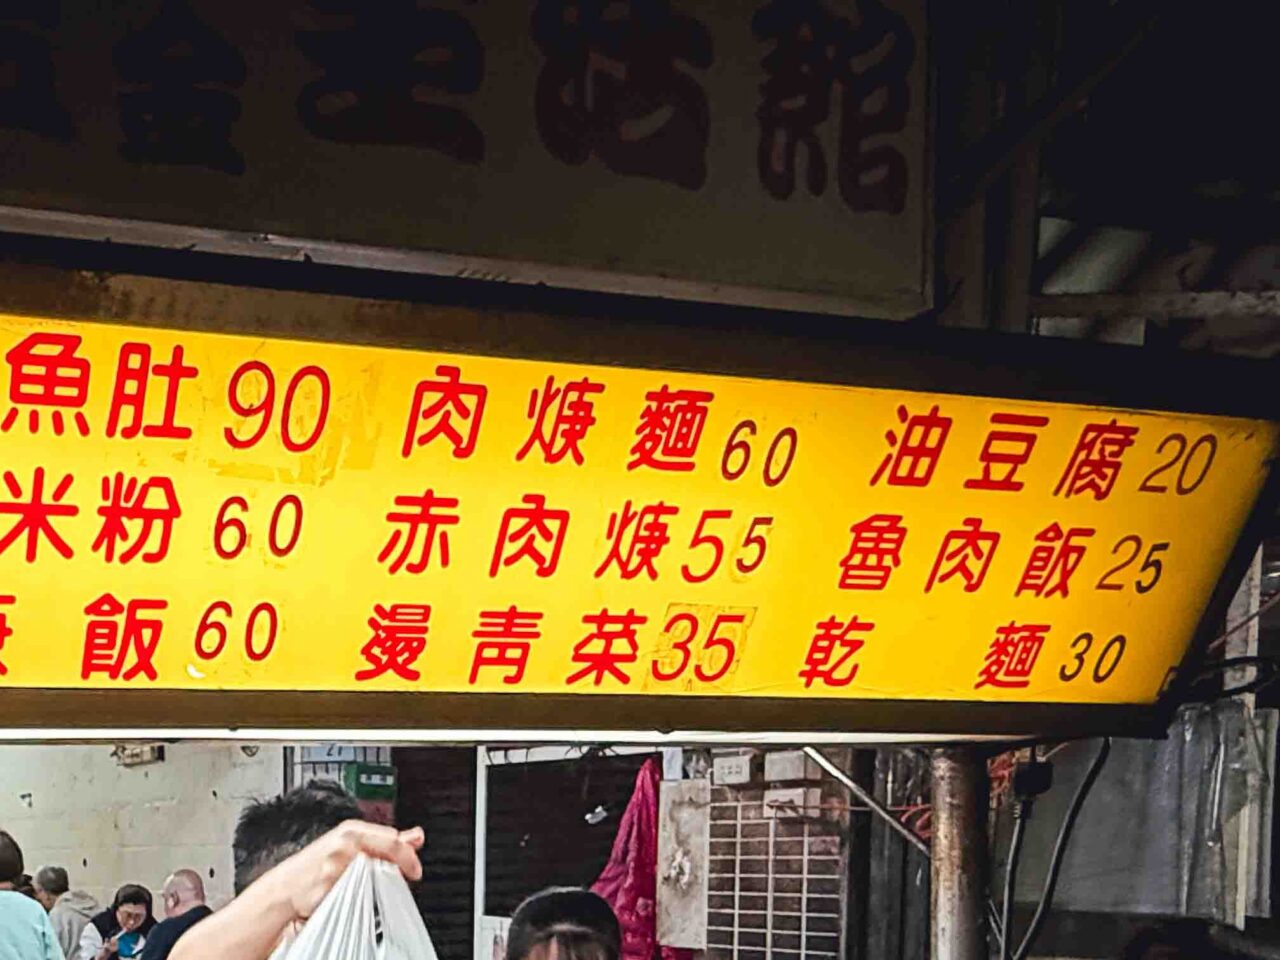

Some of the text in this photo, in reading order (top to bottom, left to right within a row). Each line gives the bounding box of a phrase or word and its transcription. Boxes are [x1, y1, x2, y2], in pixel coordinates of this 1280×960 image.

[223, 359, 331, 453] 90
[721, 426, 798, 487] 60
[870, 404, 1219, 498] 油豆腐 20
[213, 495, 303, 560] 60
[681, 509, 772, 583] 55
[839, 514, 1165, 599] 魯肉飯 25
[194, 601, 278, 660] 60
[355, 603, 737, 686] 燙青菜 35
[799, 616, 1127, 690] 乾麵 30
